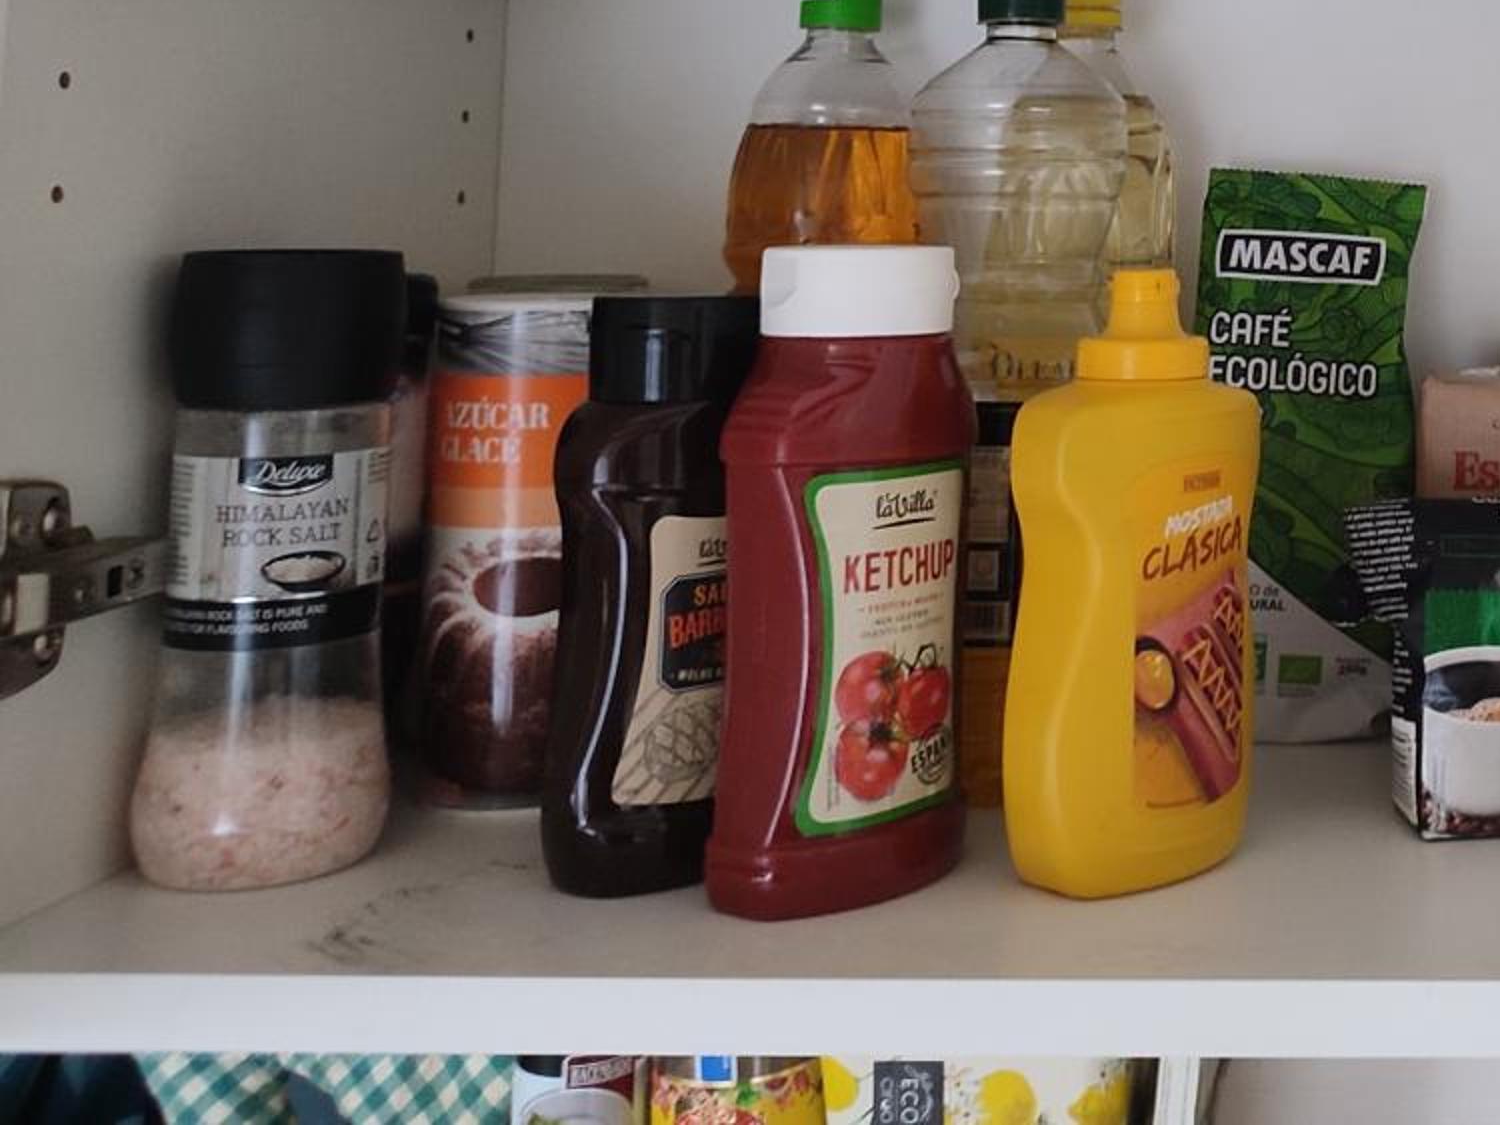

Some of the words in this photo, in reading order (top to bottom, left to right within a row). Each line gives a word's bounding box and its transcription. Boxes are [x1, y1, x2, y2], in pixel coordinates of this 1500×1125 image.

[1228, 238, 1372, 275] MASCAF
[1210, 308, 1292, 348] CAFÉ
[1209, 352, 1378, 397] ECOLÓGICO
[448, 395, 549, 431] AZÚCAR
[256, 460, 327, 486] Deluxe
[216, 497, 350, 525] HIMALAYAN
[223, 528, 282, 548] ROCK
[289, 522, 342, 546] SALT
[1143, 514, 1242, 581] CLÁSICA
[843, 538, 955, 594] KETCHUP
